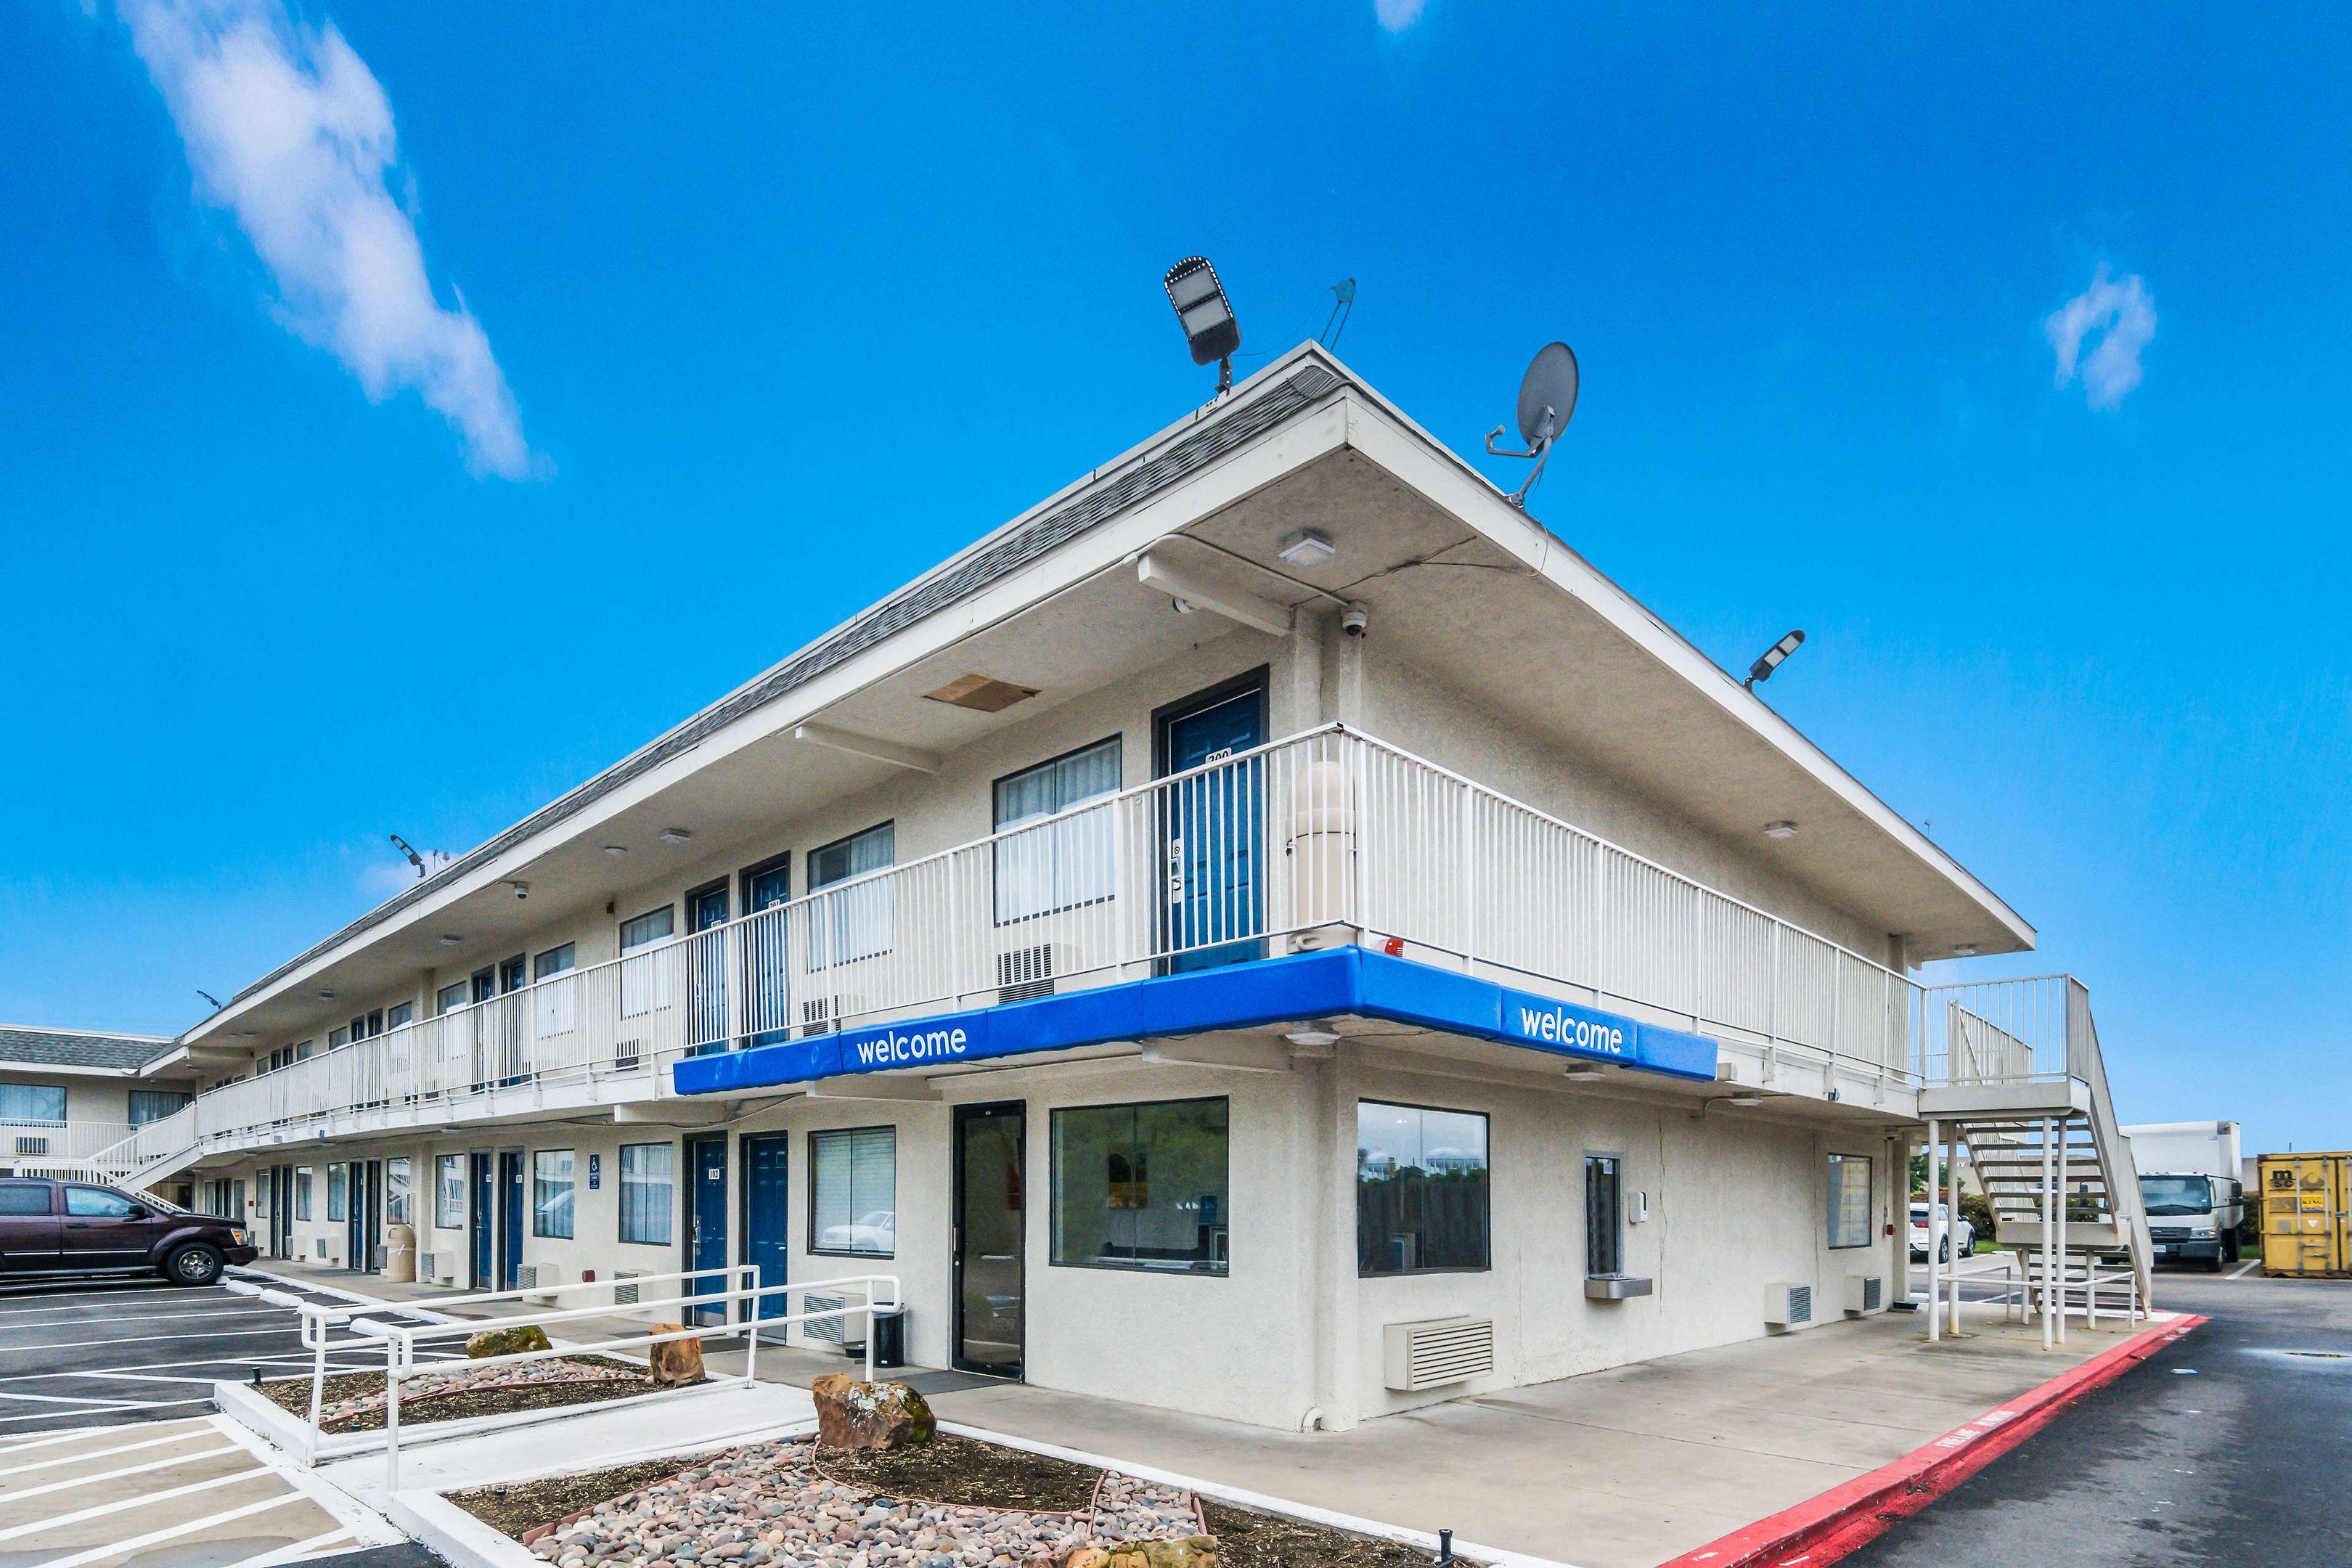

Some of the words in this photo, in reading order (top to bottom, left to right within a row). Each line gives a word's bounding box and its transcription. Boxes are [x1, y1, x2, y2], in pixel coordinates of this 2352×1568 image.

[857, 1028, 967, 1064] welcome
[1521, 1005, 1623, 1055] welcome
[710, 1169, 719, 1178] 102
